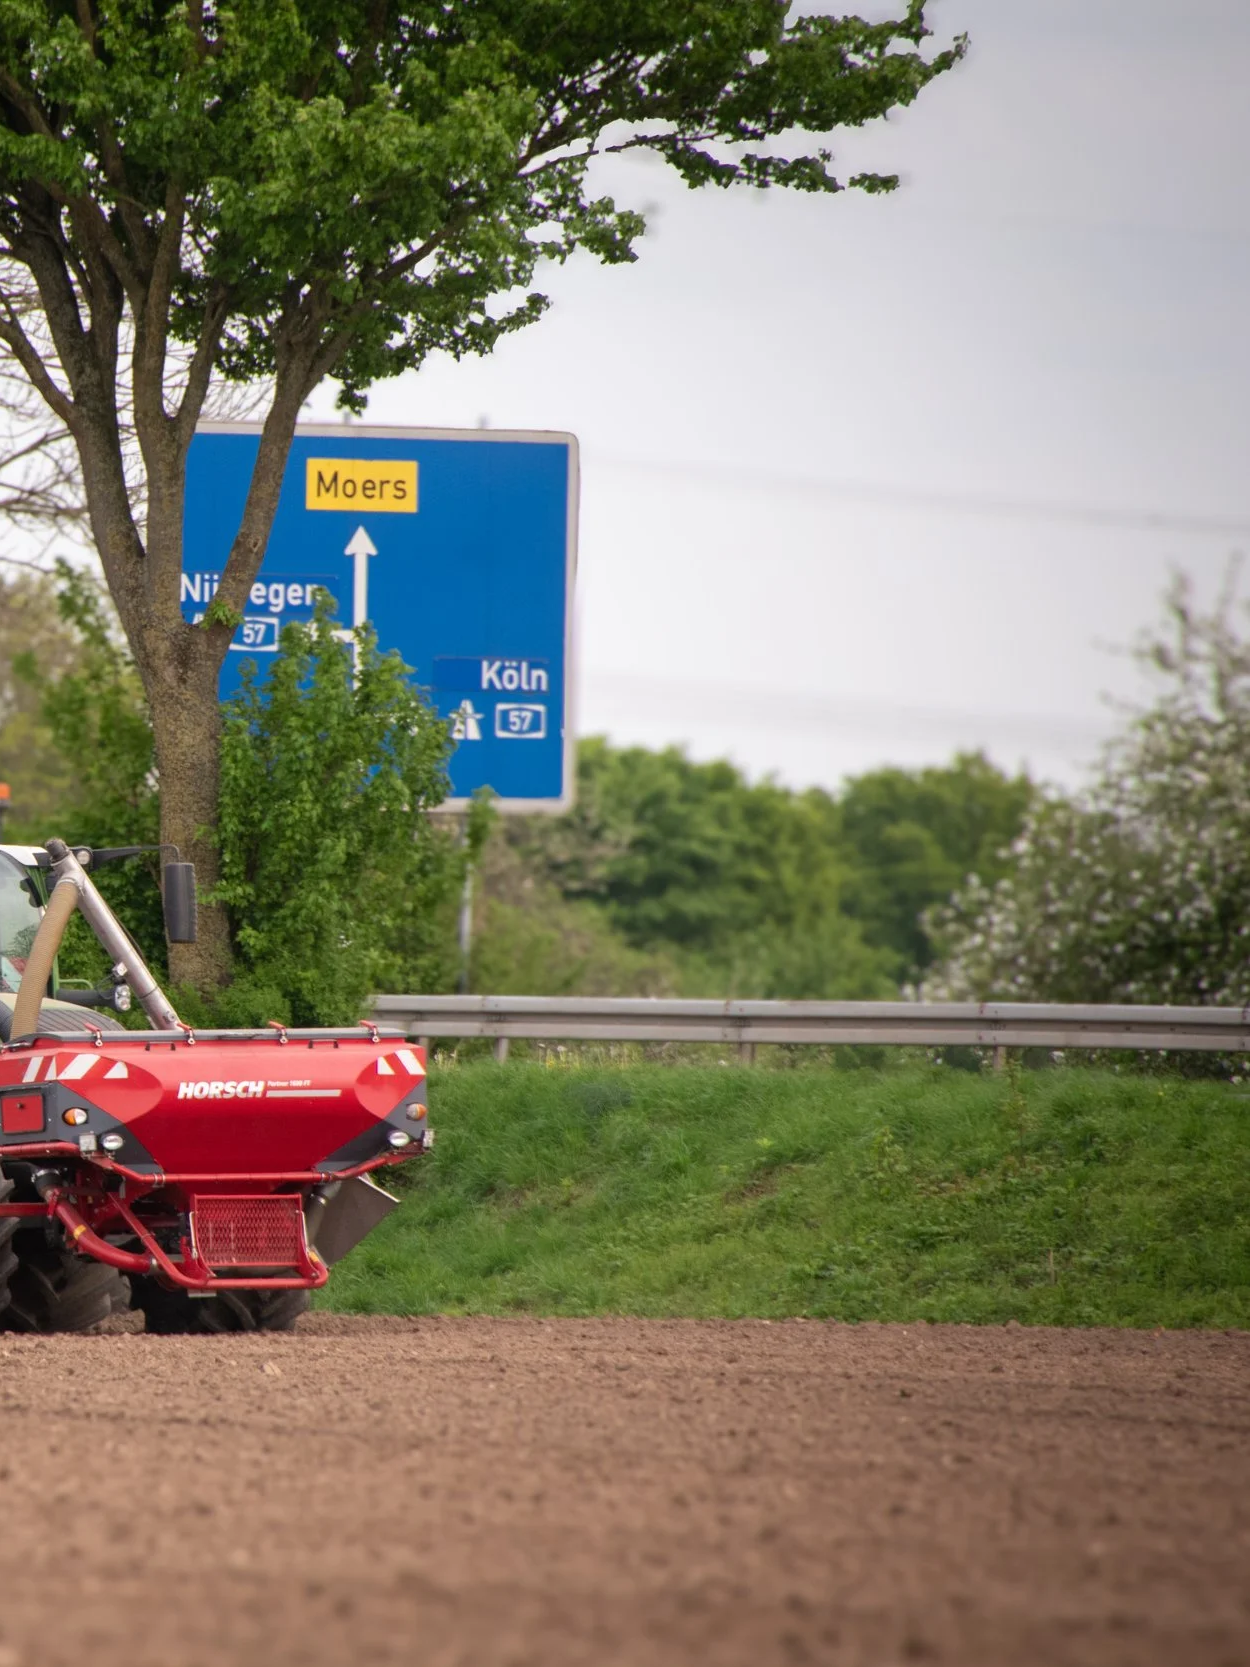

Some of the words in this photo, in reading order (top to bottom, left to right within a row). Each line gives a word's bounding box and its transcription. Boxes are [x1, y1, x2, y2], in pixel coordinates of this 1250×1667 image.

[316, 470, 407, 500] Moers
[242, 623, 266, 645] 57
[481, 660, 548, 691] Köln
[508, 710, 533, 732] 57
[177, 1080, 265, 1100] HORSCH
